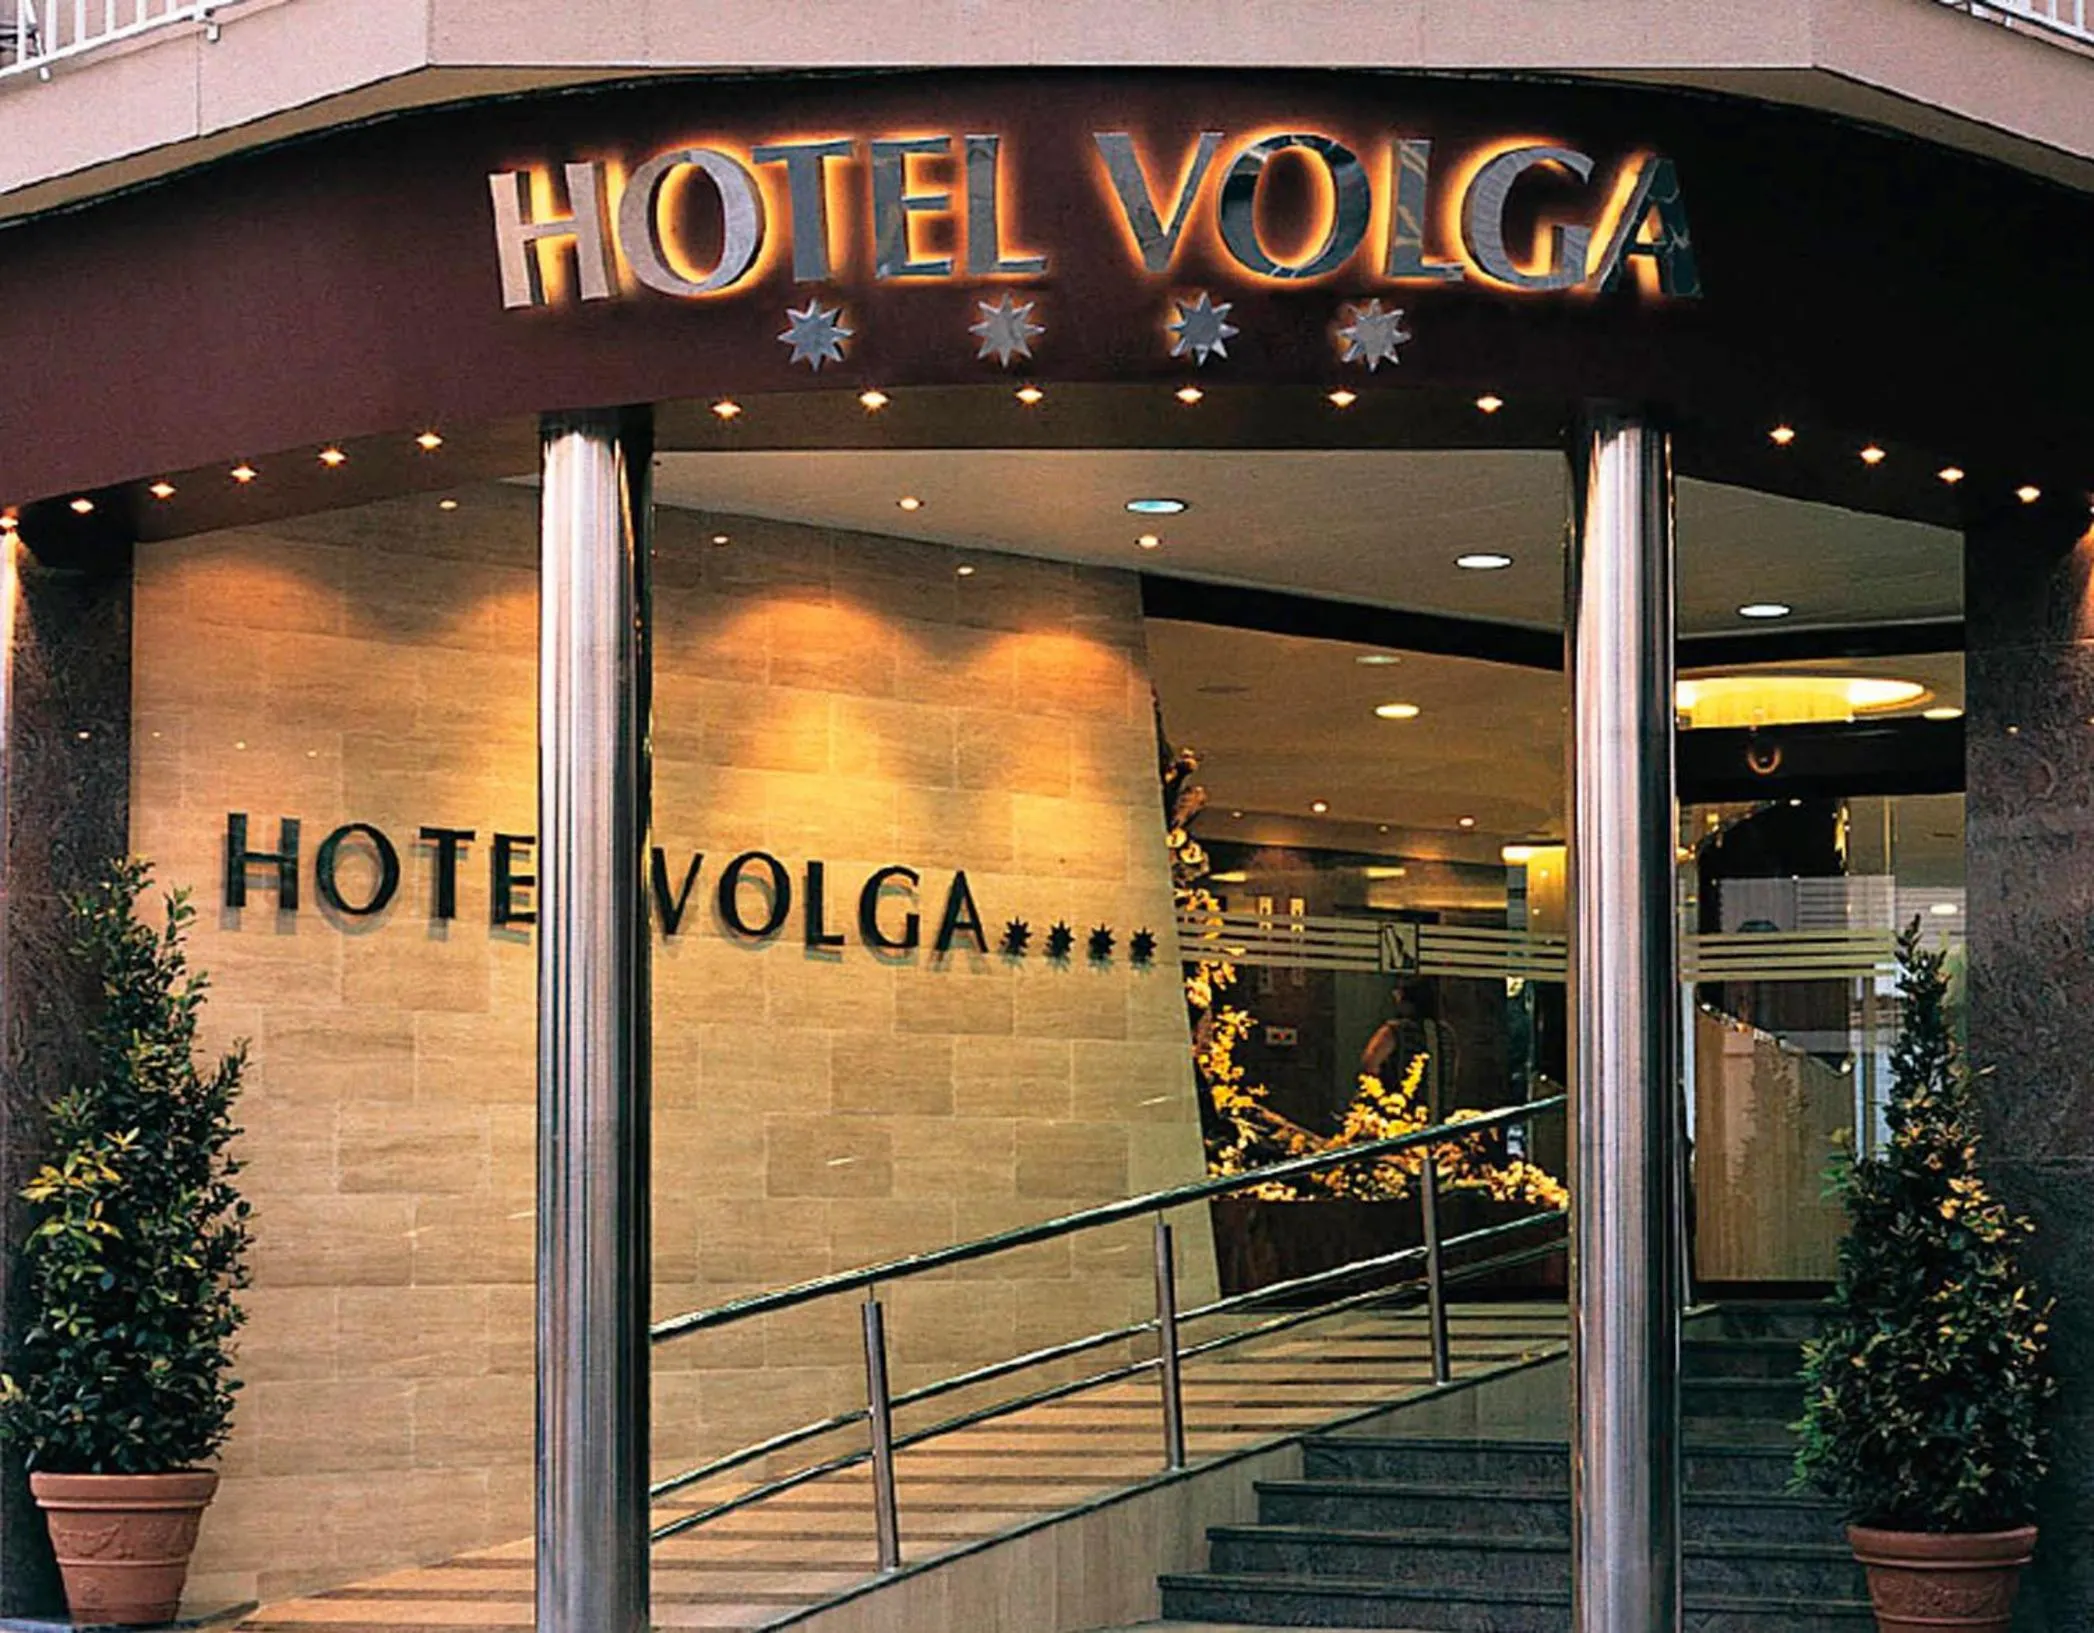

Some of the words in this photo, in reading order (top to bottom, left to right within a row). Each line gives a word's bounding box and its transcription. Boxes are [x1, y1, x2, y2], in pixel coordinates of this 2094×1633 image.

[488, 133, 1049, 309] HOTEL
[1093, 132, 1703, 299] VOLGA
[227, 813, 537, 926] HOTE
[650, 847, 989, 953] VOLGA
